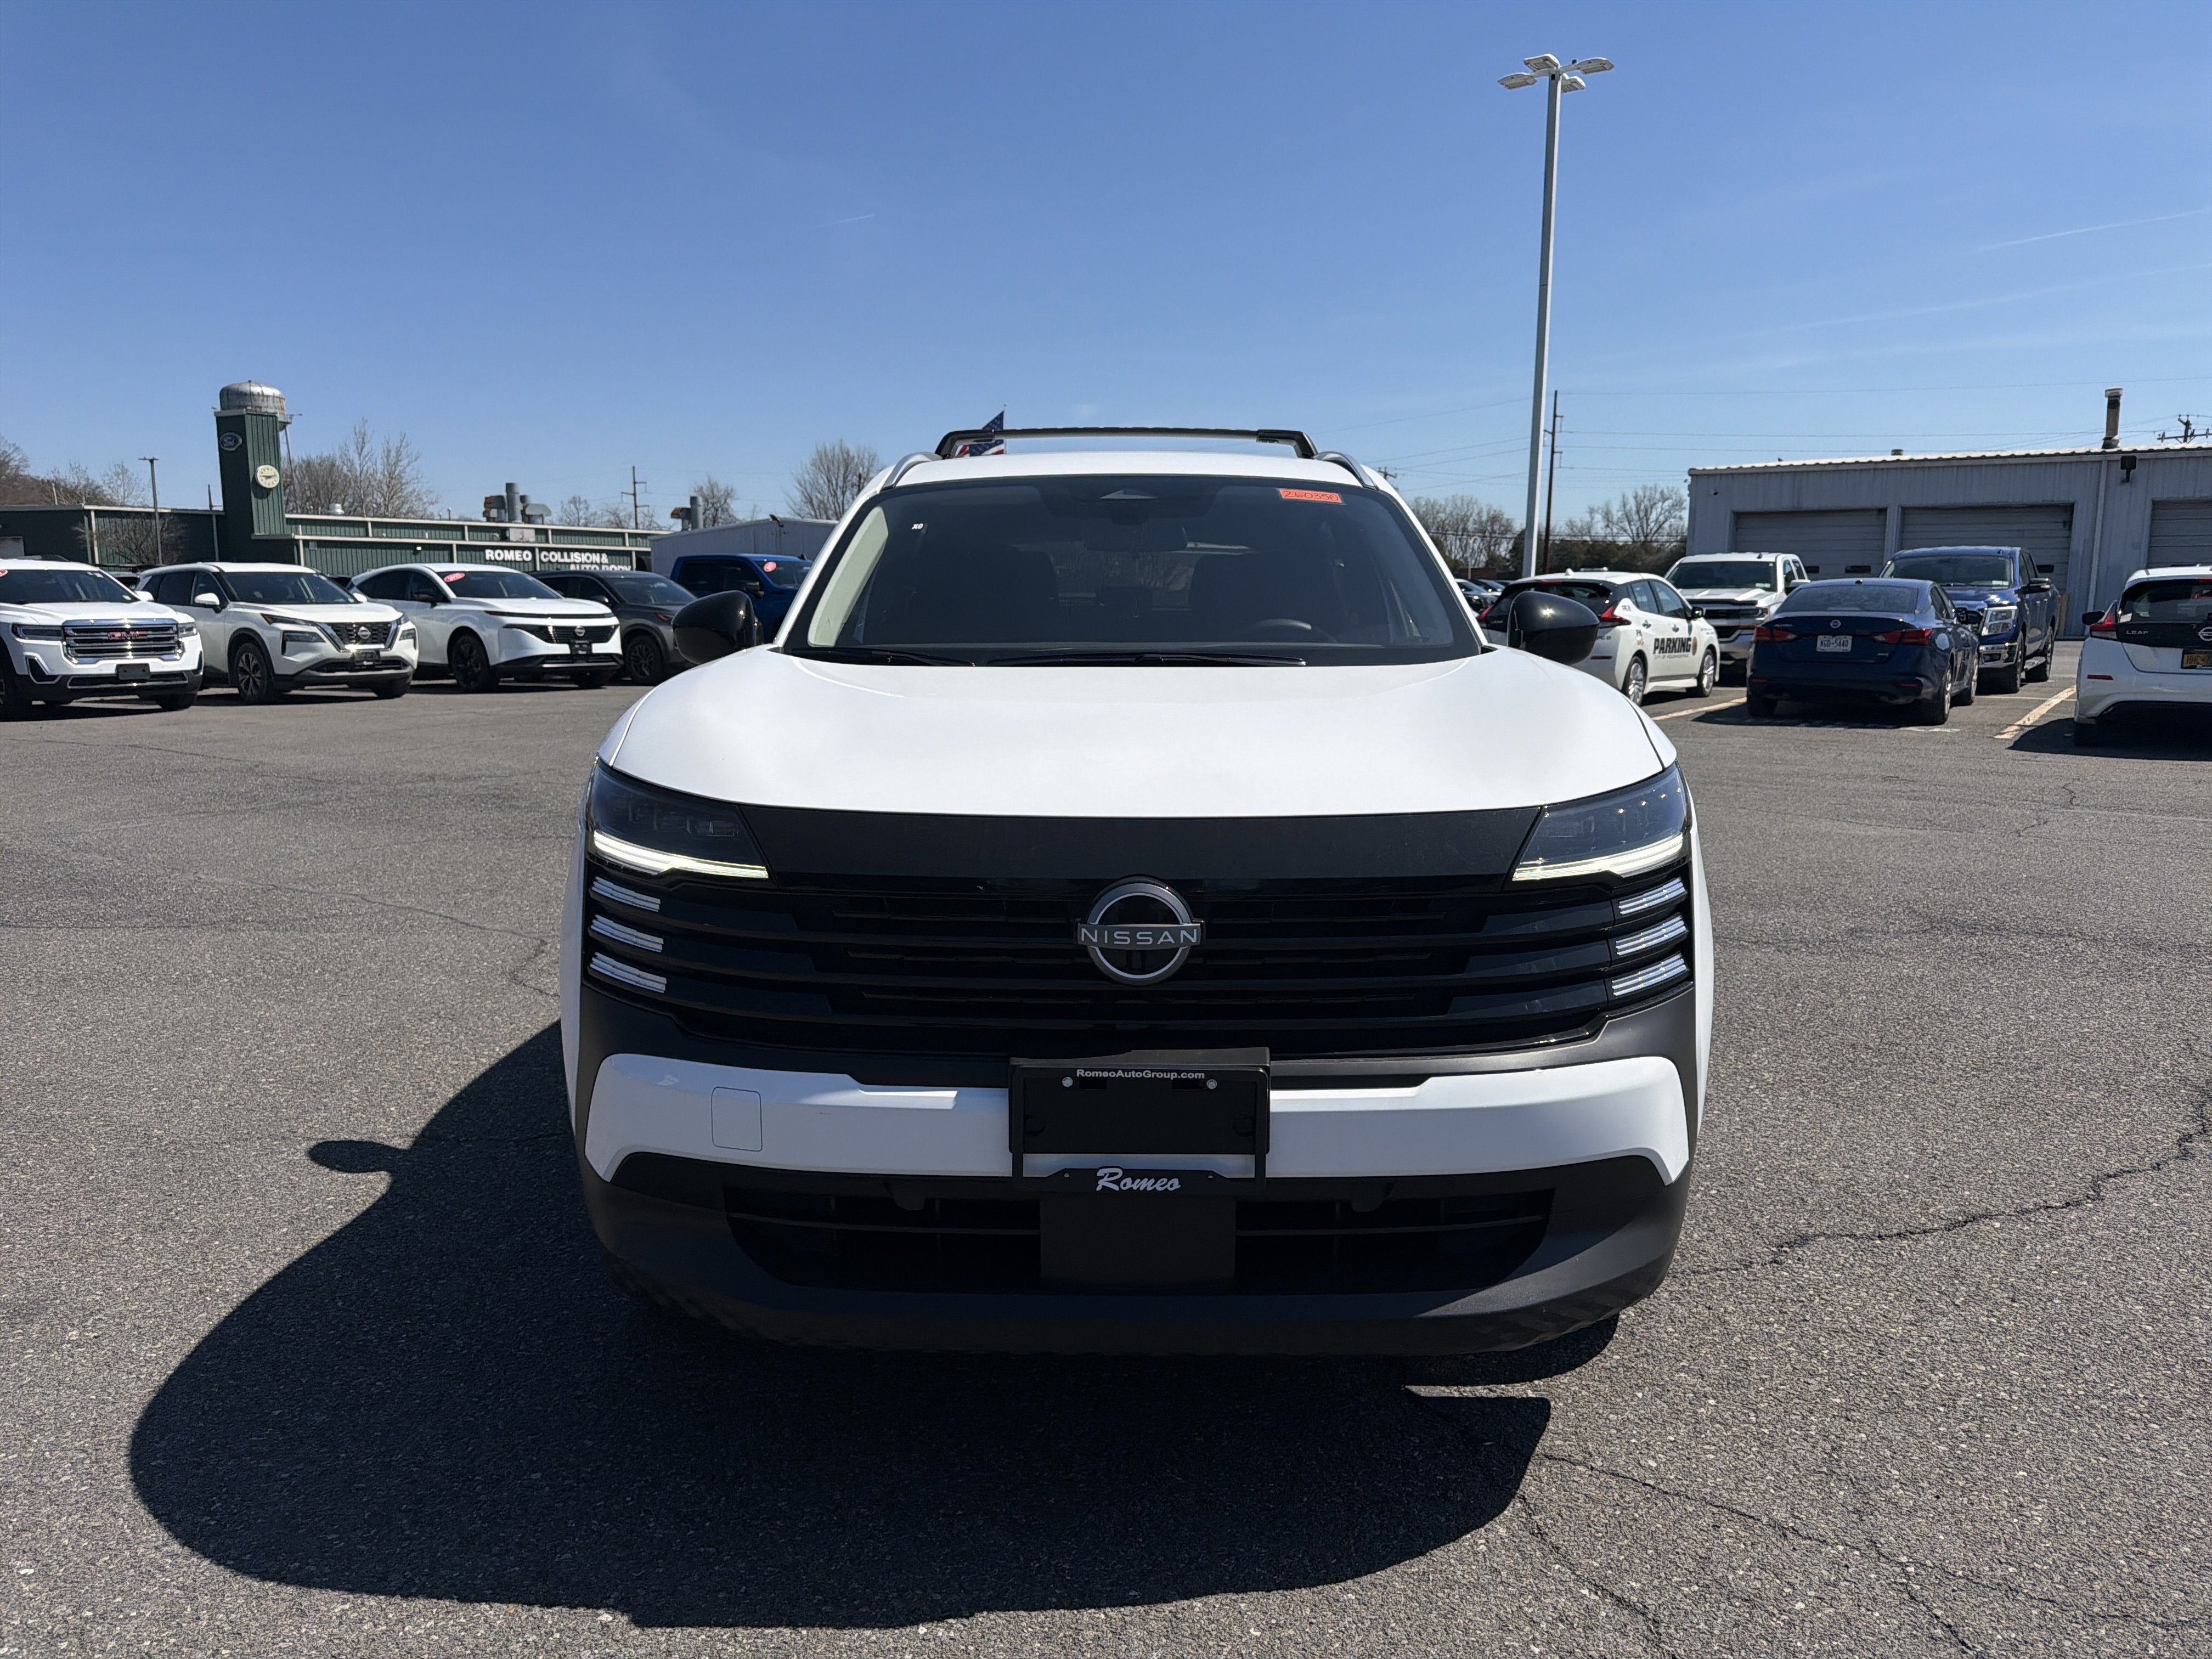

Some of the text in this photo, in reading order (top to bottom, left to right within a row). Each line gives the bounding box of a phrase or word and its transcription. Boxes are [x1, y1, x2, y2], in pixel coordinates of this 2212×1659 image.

[485, 549, 532, 562] ROMEO
[540, 551, 600, 563] COLLISION
[108, 631, 148, 640] GMC
[1652, 637, 1692, 655] PARKING
[1081, 928, 1197, 945] NISSAN
[1076, 1069, 1205, 1080] RomeoAutoGroup.com
[1096, 1167, 1181, 1192] Romeo
